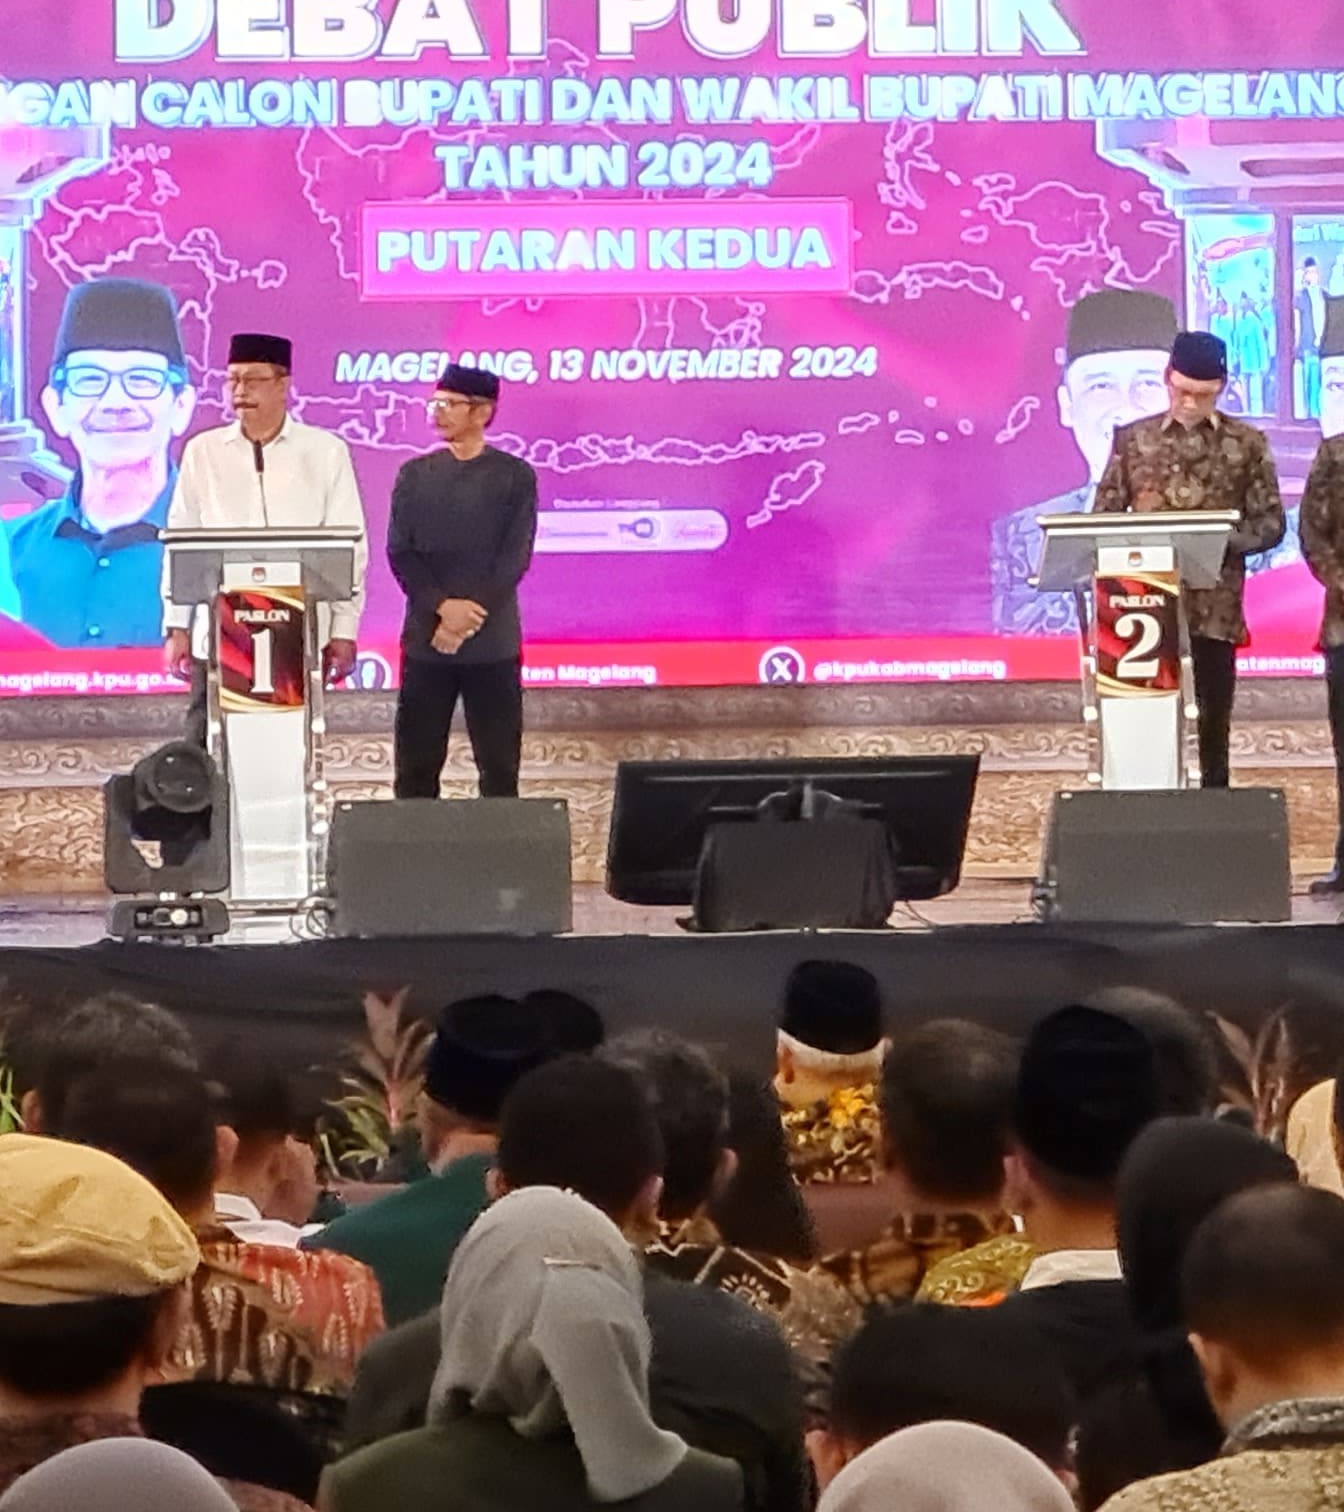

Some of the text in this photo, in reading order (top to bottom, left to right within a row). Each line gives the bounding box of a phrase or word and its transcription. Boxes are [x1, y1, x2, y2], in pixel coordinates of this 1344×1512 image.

[140, 78, 338, 127] CALON
[343, 76, 543, 126] BUPATI
[554, 76, 673, 124] DAN
[678, 75, 862, 124] WAKIL
[863, 73, 1063, 123] BUPATI
[434, 140, 774, 189] TAHUN 2024
[376, 228, 832, 273] PUTARAN KEDUA
[548, 349, 583, 380] 13
[590, 348, 783, 382] NOVEMBER
[788, 347, 879, 378] 2024
[250, 627, 275, 694] 1
[1114, 612, 1161, 678] 2
[557, 663, 657, 685] Magelang
[812, 658, 1006, 681] @kpukabmagelang
